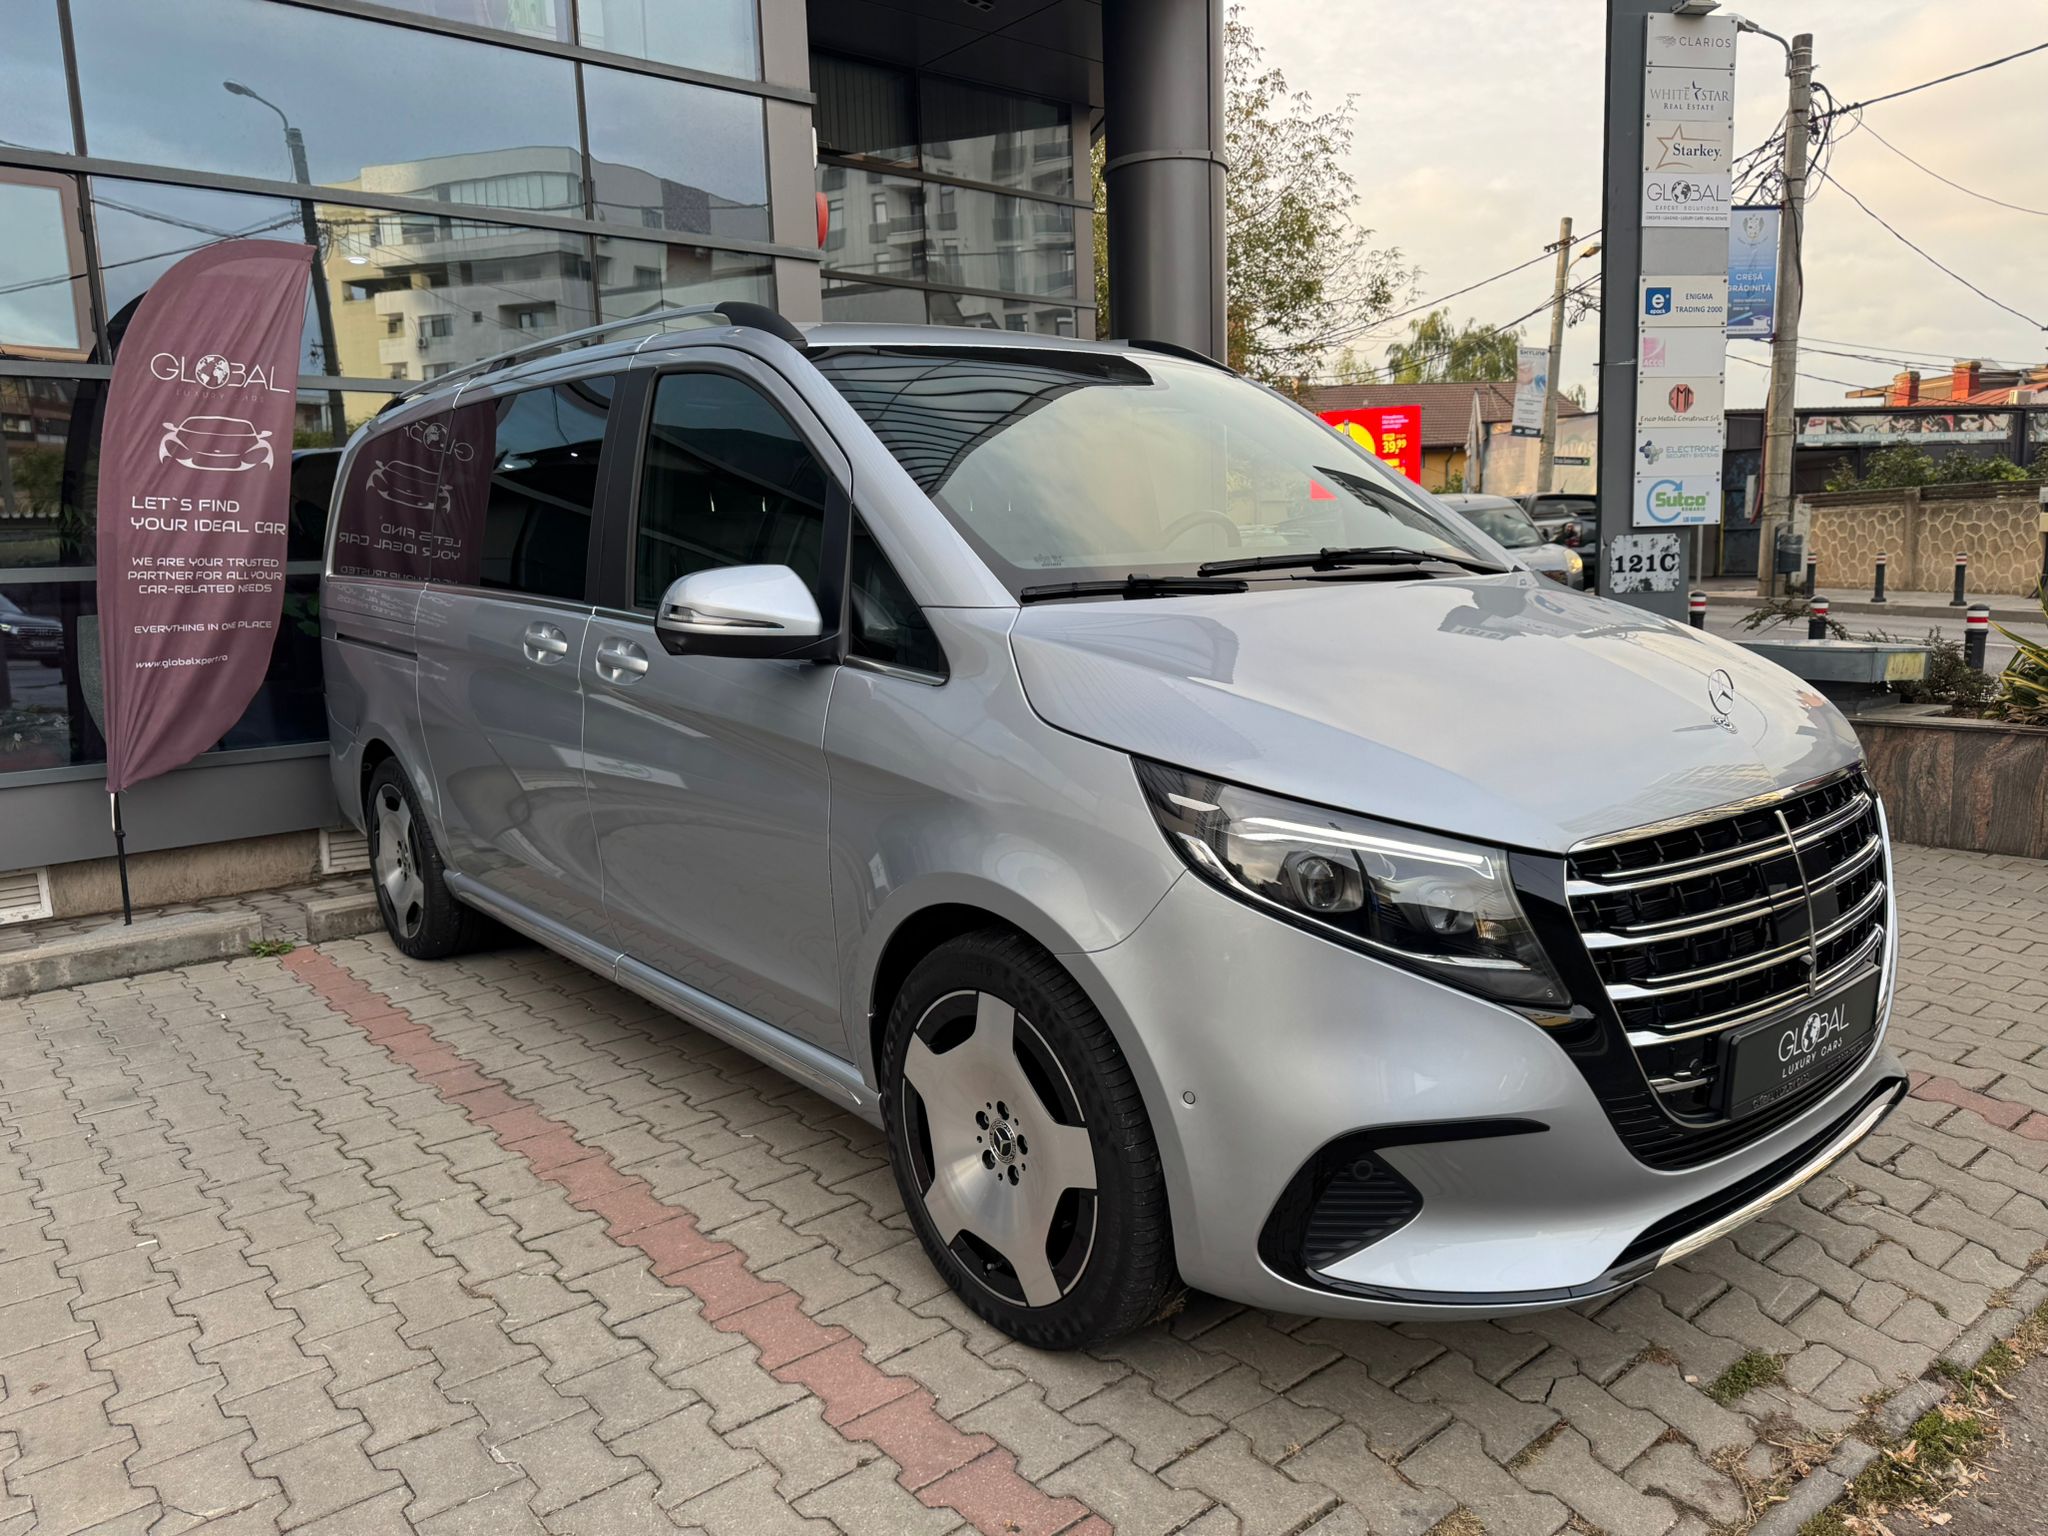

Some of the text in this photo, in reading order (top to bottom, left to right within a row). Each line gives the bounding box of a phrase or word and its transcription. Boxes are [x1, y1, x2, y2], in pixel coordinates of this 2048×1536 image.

[1679, 36, 1732, 48] CLARIOS
[1650, 86, 1729, 101] WHITE STAR
[1647, 180, 1728, 204] GLOBAL
[150, 352, 291, 393] GLOBAL
[199, 499, 240, 513] FIND
[1655, 492, 1706, 508] Sutco
[131, 517, 287, 536] YOUR IDEAL CAR
[132, 557, 280, 568] WE ARE YOUR TRUSTED
[1614, 553, 1677, 574] 121C
[128, 571, 283, 580] PARTNER FOR ALL YOUR
[138, 583, 273, 594] CAR-RELATED NEEDS
[134, 623, 205, 634] EVERYTHING
[207, 623, 219, 631] IN
[237, 620, 272, 630] PLACE
[1778, 1003, 1850, 1062] GLOBAL
[1782, 1051, 1817, 1078] LUXURY
[1820, 1037, 1843, 1057] CARS
